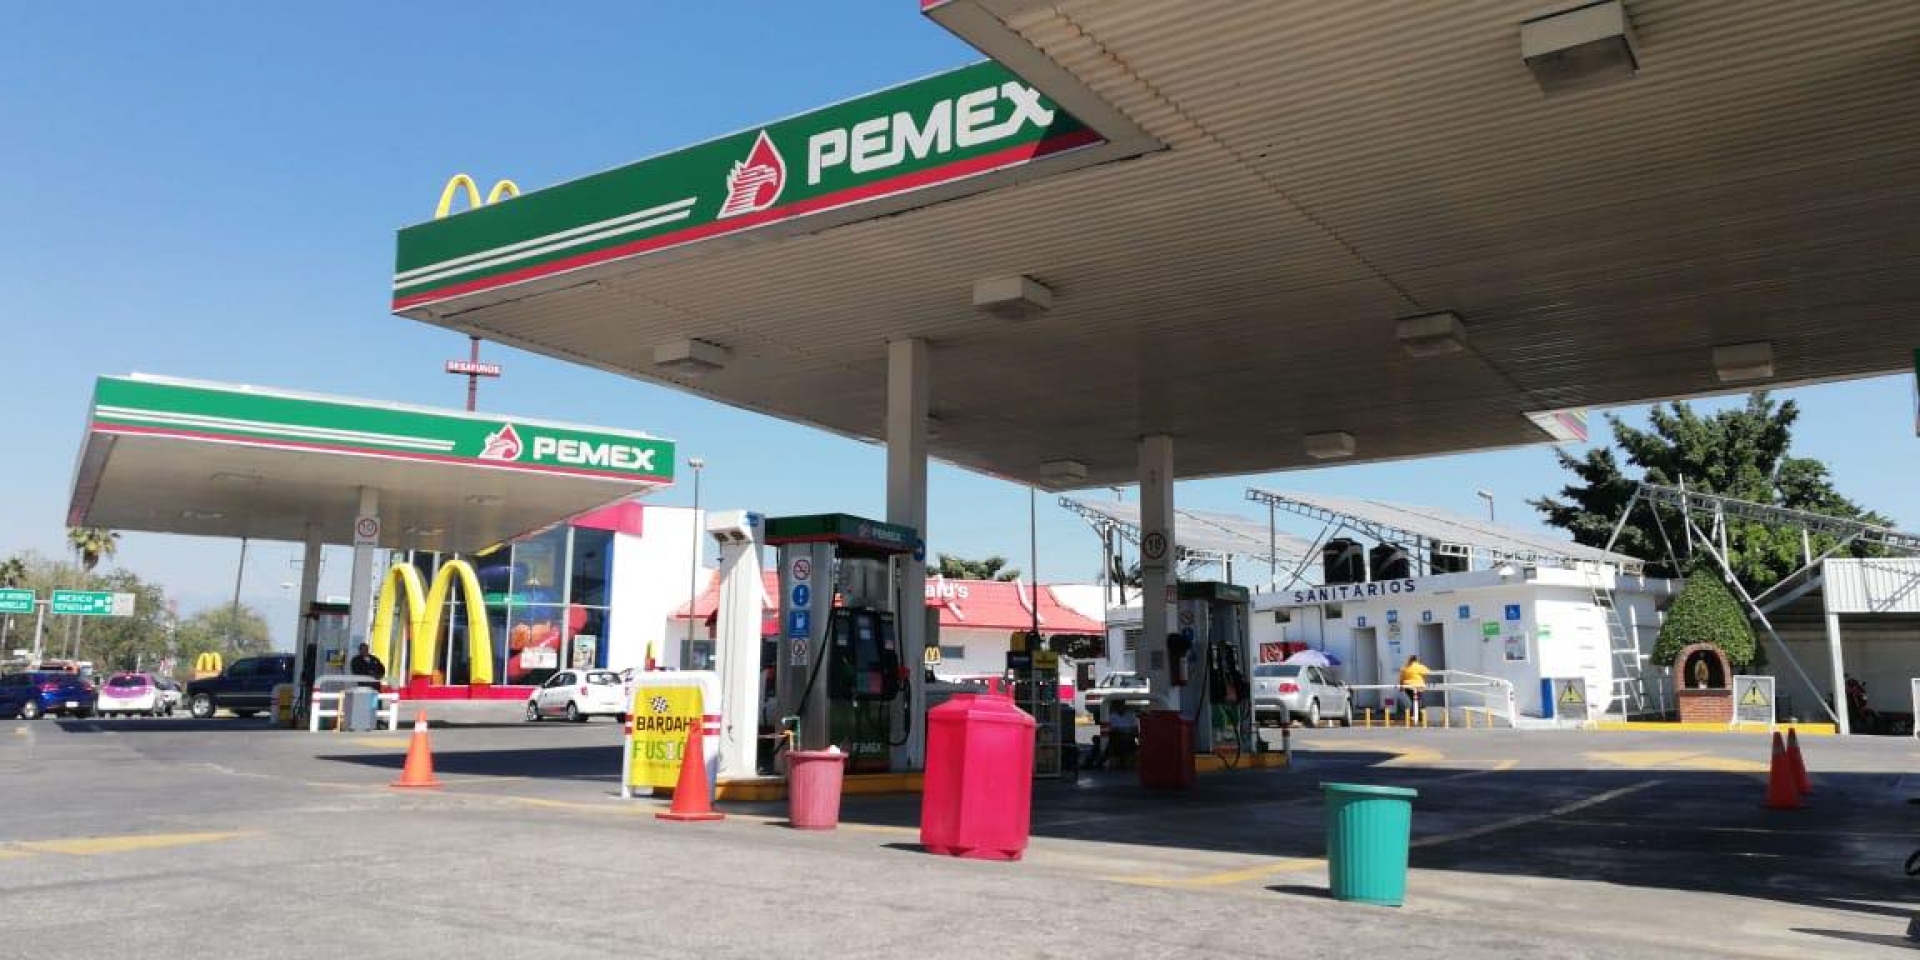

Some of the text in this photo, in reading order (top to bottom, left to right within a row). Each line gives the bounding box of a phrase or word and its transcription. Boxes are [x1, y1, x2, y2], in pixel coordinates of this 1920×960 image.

[807, 80, 1054, 186] PEMEX
[532, 436, 656, 471] PEMEX
[925, 582, 969, 599] ald's
[1294, 578, 1416, 603] SANITARIOS
[636, 715, 695, 734] BARDAH
[632, 737, 687, 761] FUSIÓ
